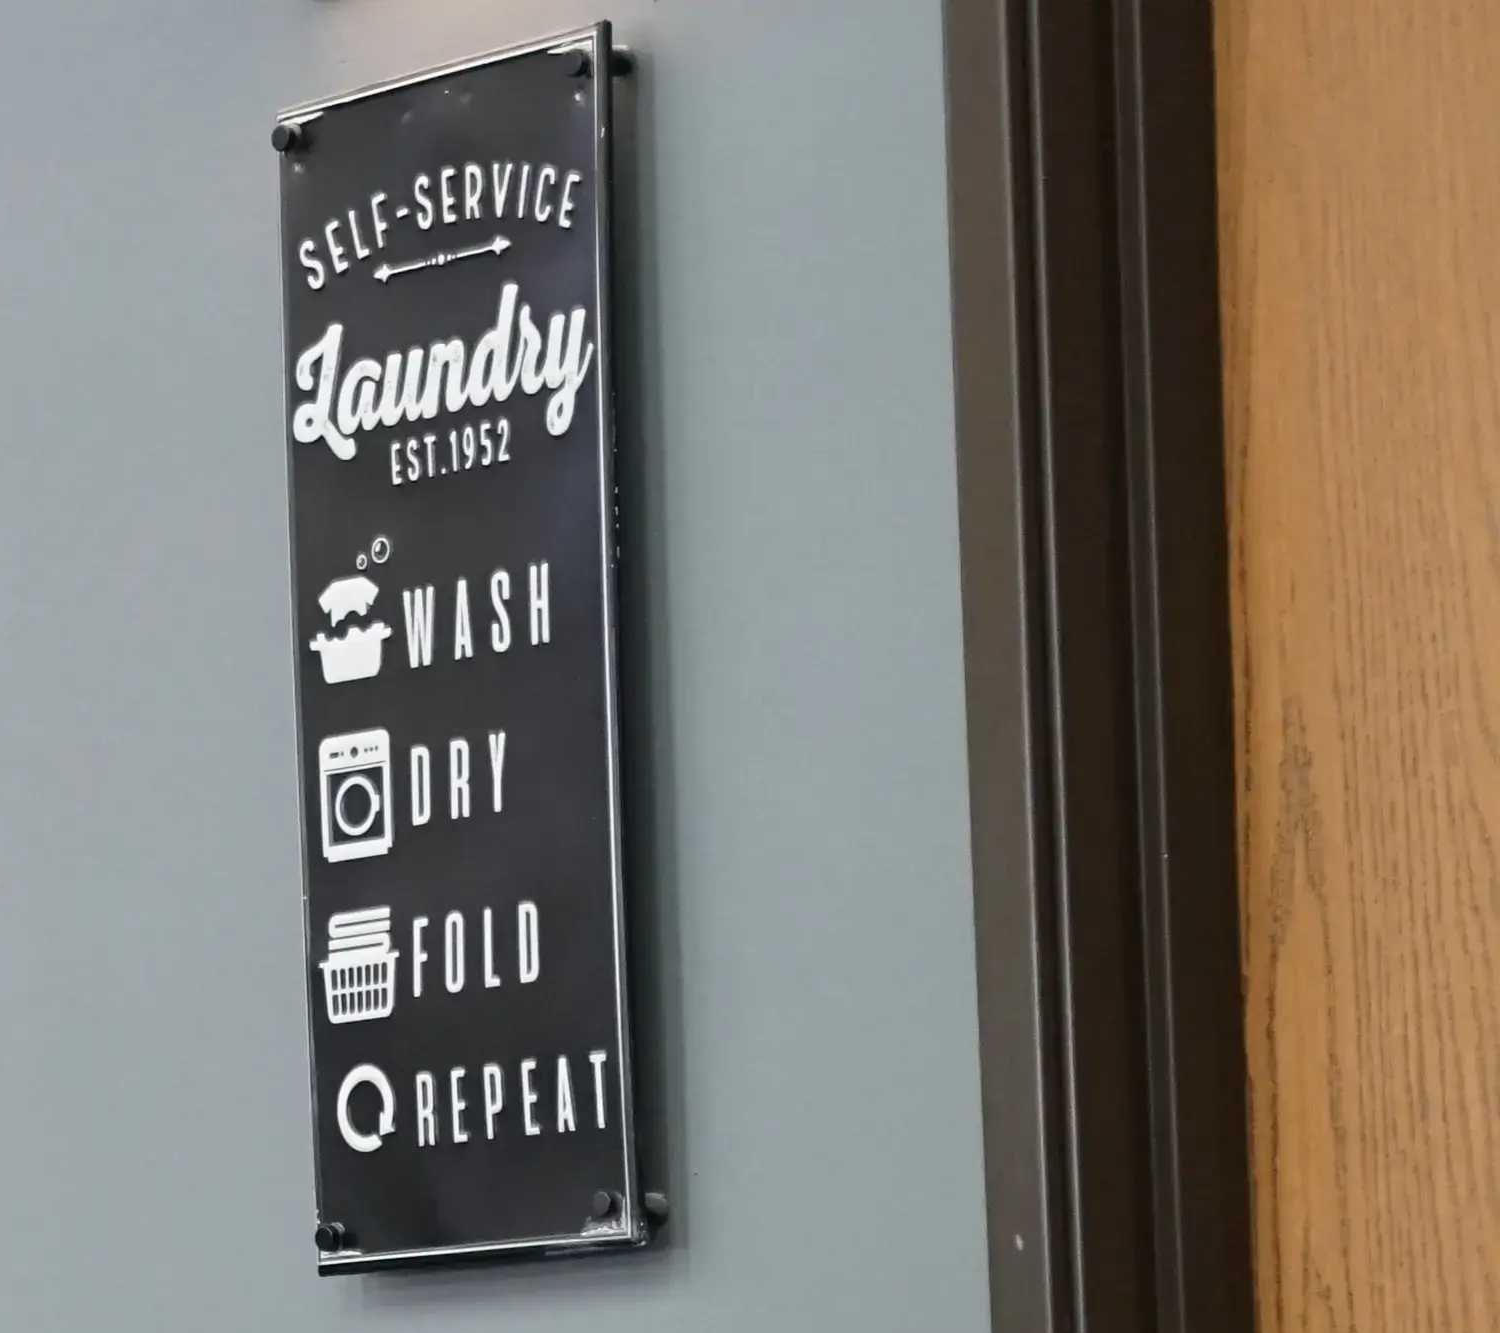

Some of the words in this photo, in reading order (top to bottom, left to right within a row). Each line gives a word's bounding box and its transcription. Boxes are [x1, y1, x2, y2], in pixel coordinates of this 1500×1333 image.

[300, 163, 580, 289] SELF-SERVICE
[293, 283, 593, 461] Laundry
[403, 563, 549, 668] WASH
[411, 732, 505, 825] DRY
[413, 901, 539, 997] FOLD
[416, 1051, 606, 1146] REPEAT
